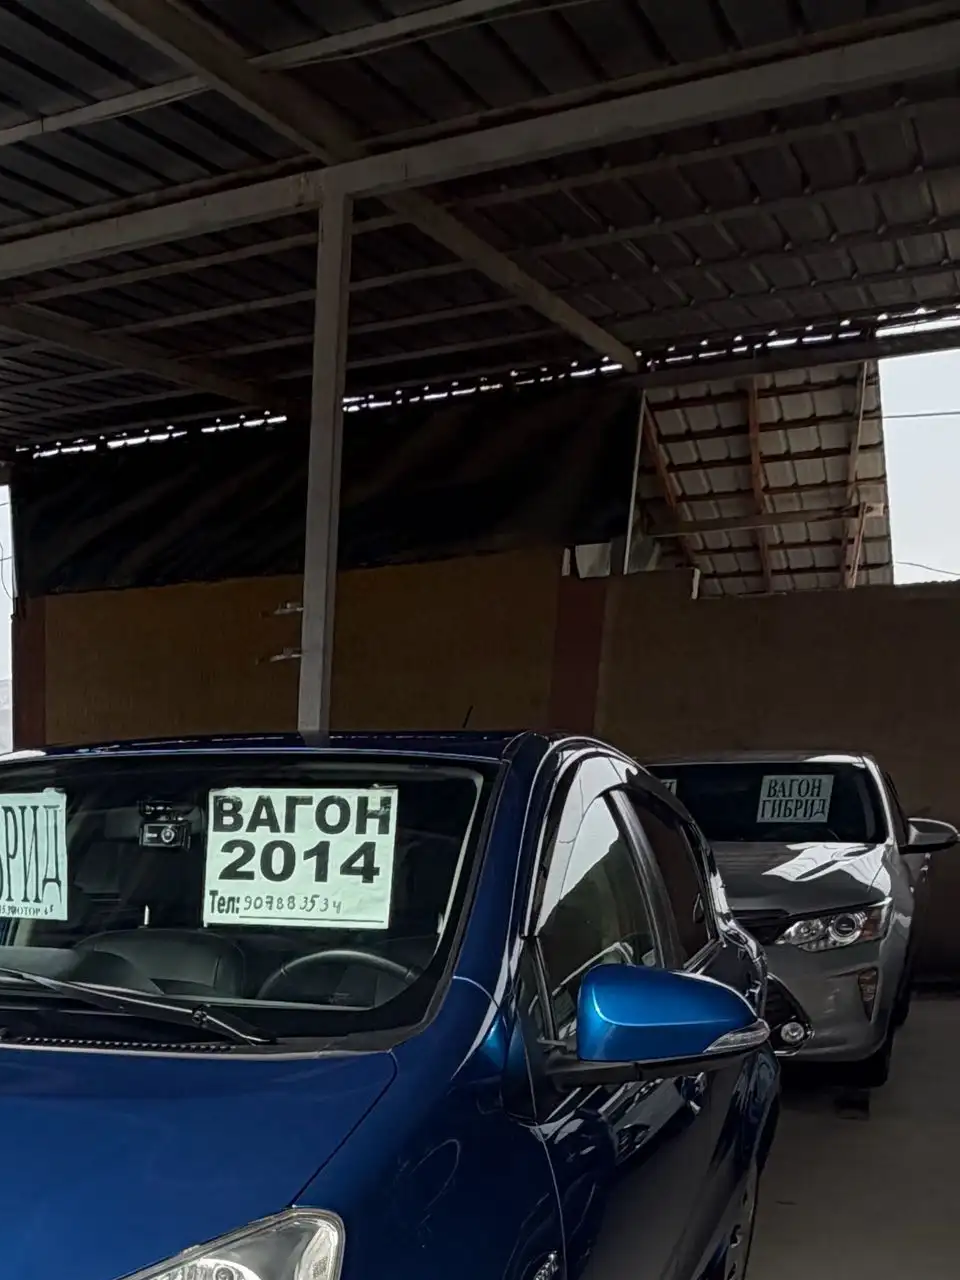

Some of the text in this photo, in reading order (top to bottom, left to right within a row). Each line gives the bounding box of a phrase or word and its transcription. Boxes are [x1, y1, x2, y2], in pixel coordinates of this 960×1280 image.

[767, 778, 822, 798] ВАГОН
[212, 794, 392, 835] ВАГОН
[761, 798, 826, 819] ГИБРИД
[218, 838, 381, 883] 2014
[209, 889, 241, 914] Тел:
